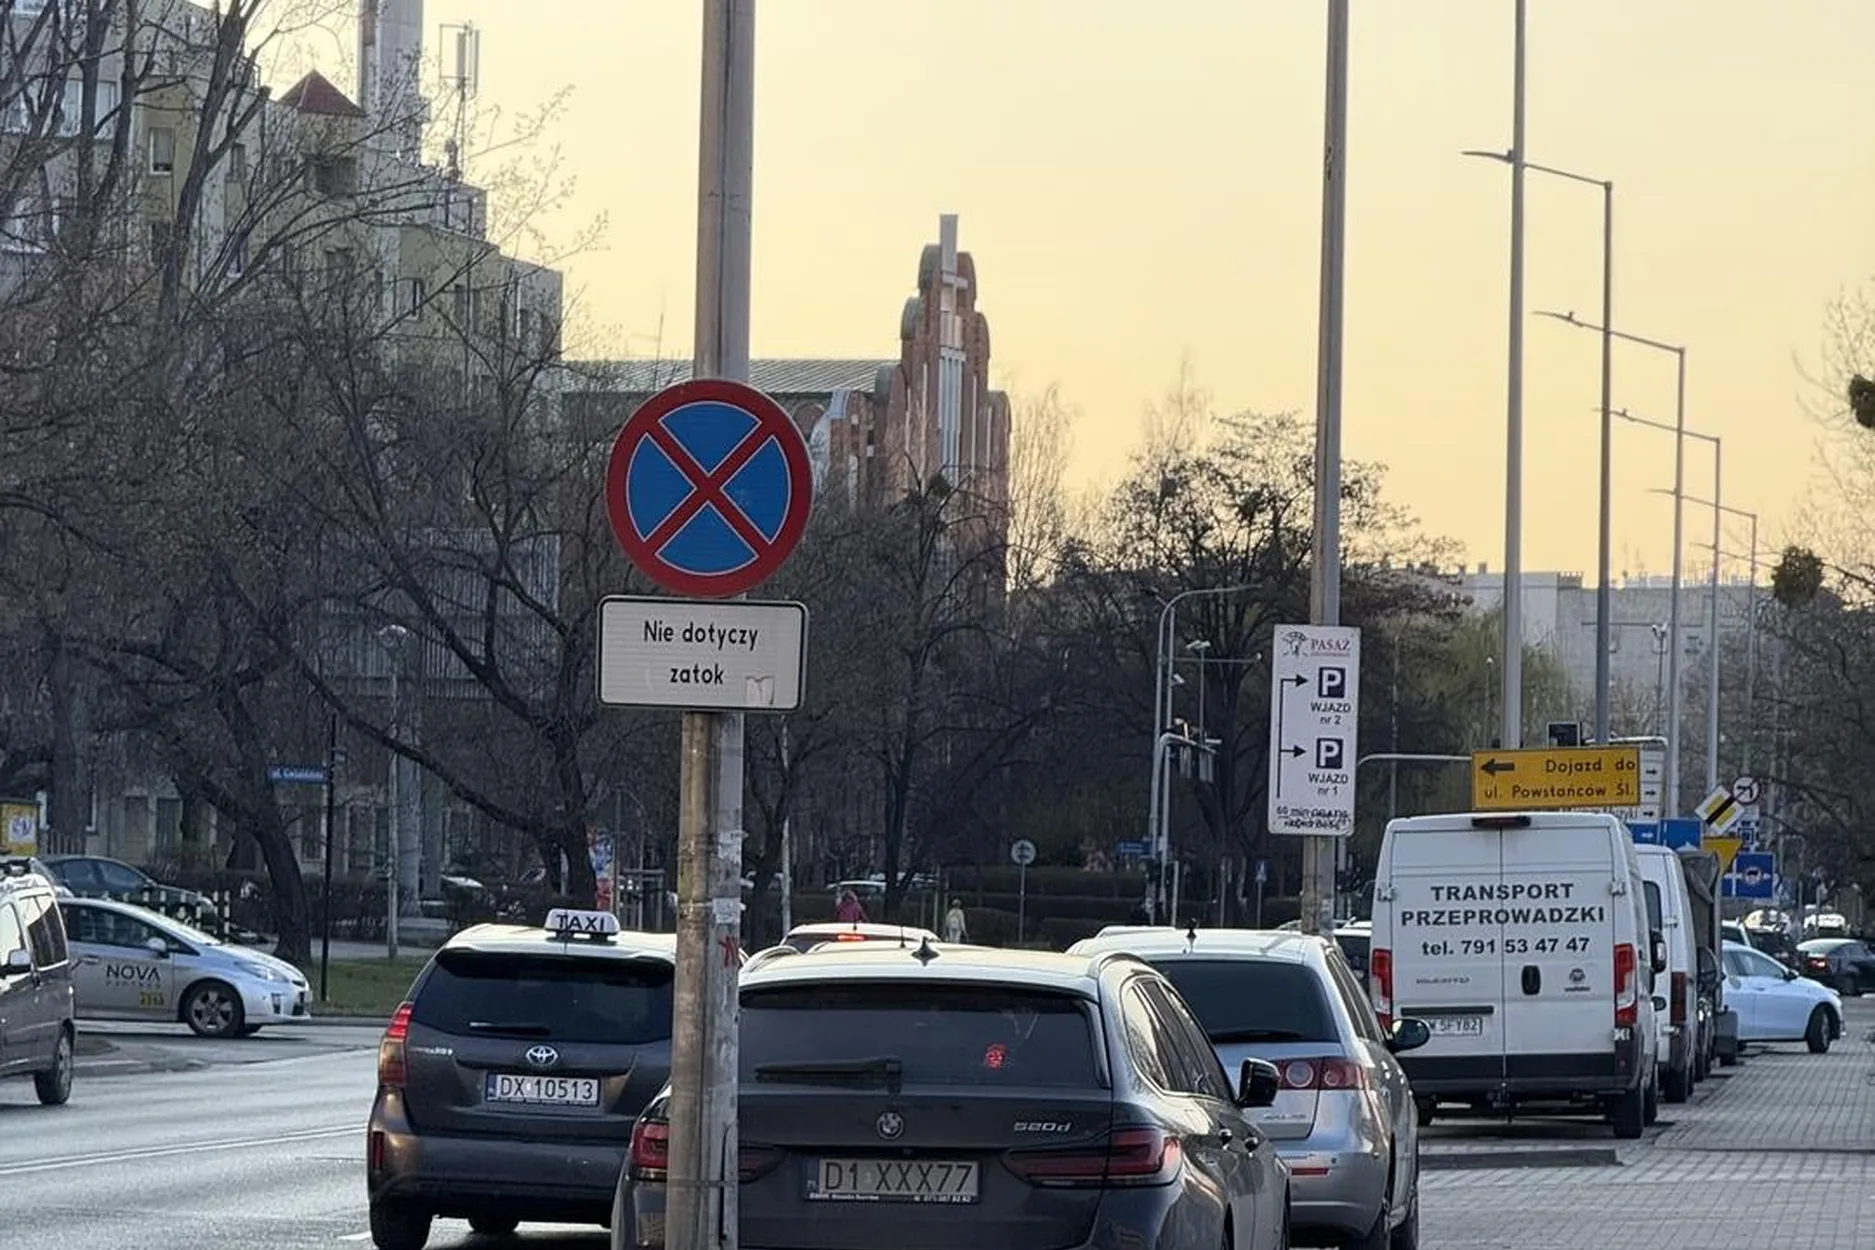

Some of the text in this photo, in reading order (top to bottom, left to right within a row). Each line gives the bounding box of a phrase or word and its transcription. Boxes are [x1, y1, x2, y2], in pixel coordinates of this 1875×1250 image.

[643, 619, 758, 651] Nie dotyczy
[669, 662, 724, 685] zatok
[1321, 668, 1343, 697] P
[1310, 701, 1351, 714] WJAZD
[1319, 714, 1342, 725] nr 2
[1319, 740, 1341, 768] P
[1545, 757, 1636, 776] Dojazd do
[1308, 772, 1349, 784] WJAZD
[1317, 785, 1338, 795] nr 1
[1484, 781, 1635, 799] ul. Powstańców Śl.
[1430, 882, 1575, 901] TRANSPORT
[555, 913, 605, 932] TAXI
[1401, 906, 1605, 926] PRZEPROWADZKI
[1422, 936, 1590, 956] tel. 791 53 47 47
[106, 964, 160, 981] NOVA
[500, 1076, 525, 1097] DX
[534, 1078, 594, 1100] 10513
[1013, 1121, 1072, 1133] 520d
[825, 1161, 974, 1193] D1 XXX77
